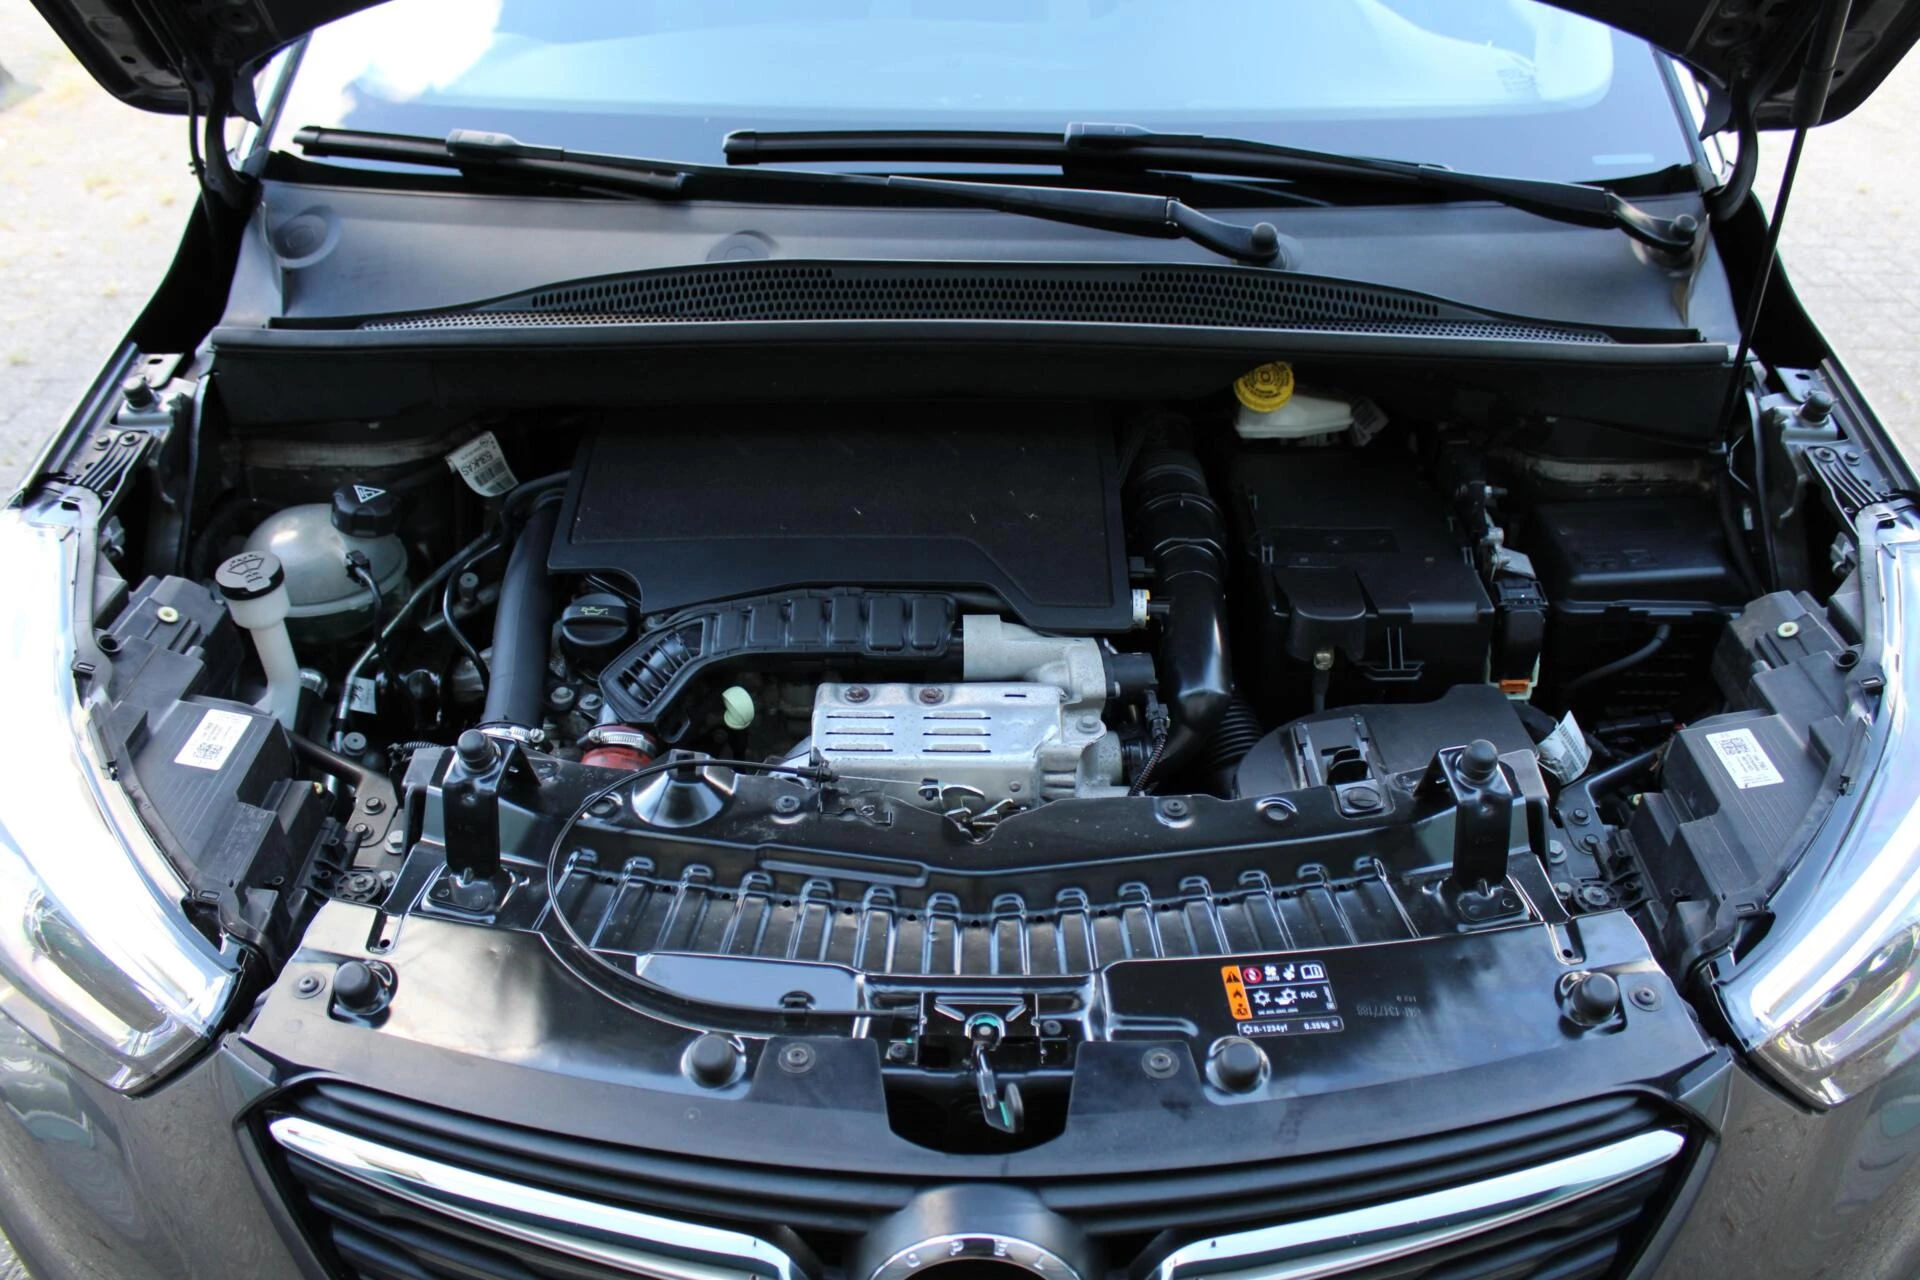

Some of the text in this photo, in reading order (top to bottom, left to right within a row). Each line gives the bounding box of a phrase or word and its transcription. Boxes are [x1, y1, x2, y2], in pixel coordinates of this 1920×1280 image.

[1300, 991, 1318, 999] PAG
[1253, 1023, 1288, 1033] R-1234yf
[905, 1240, 1044, 1271] OPEL
